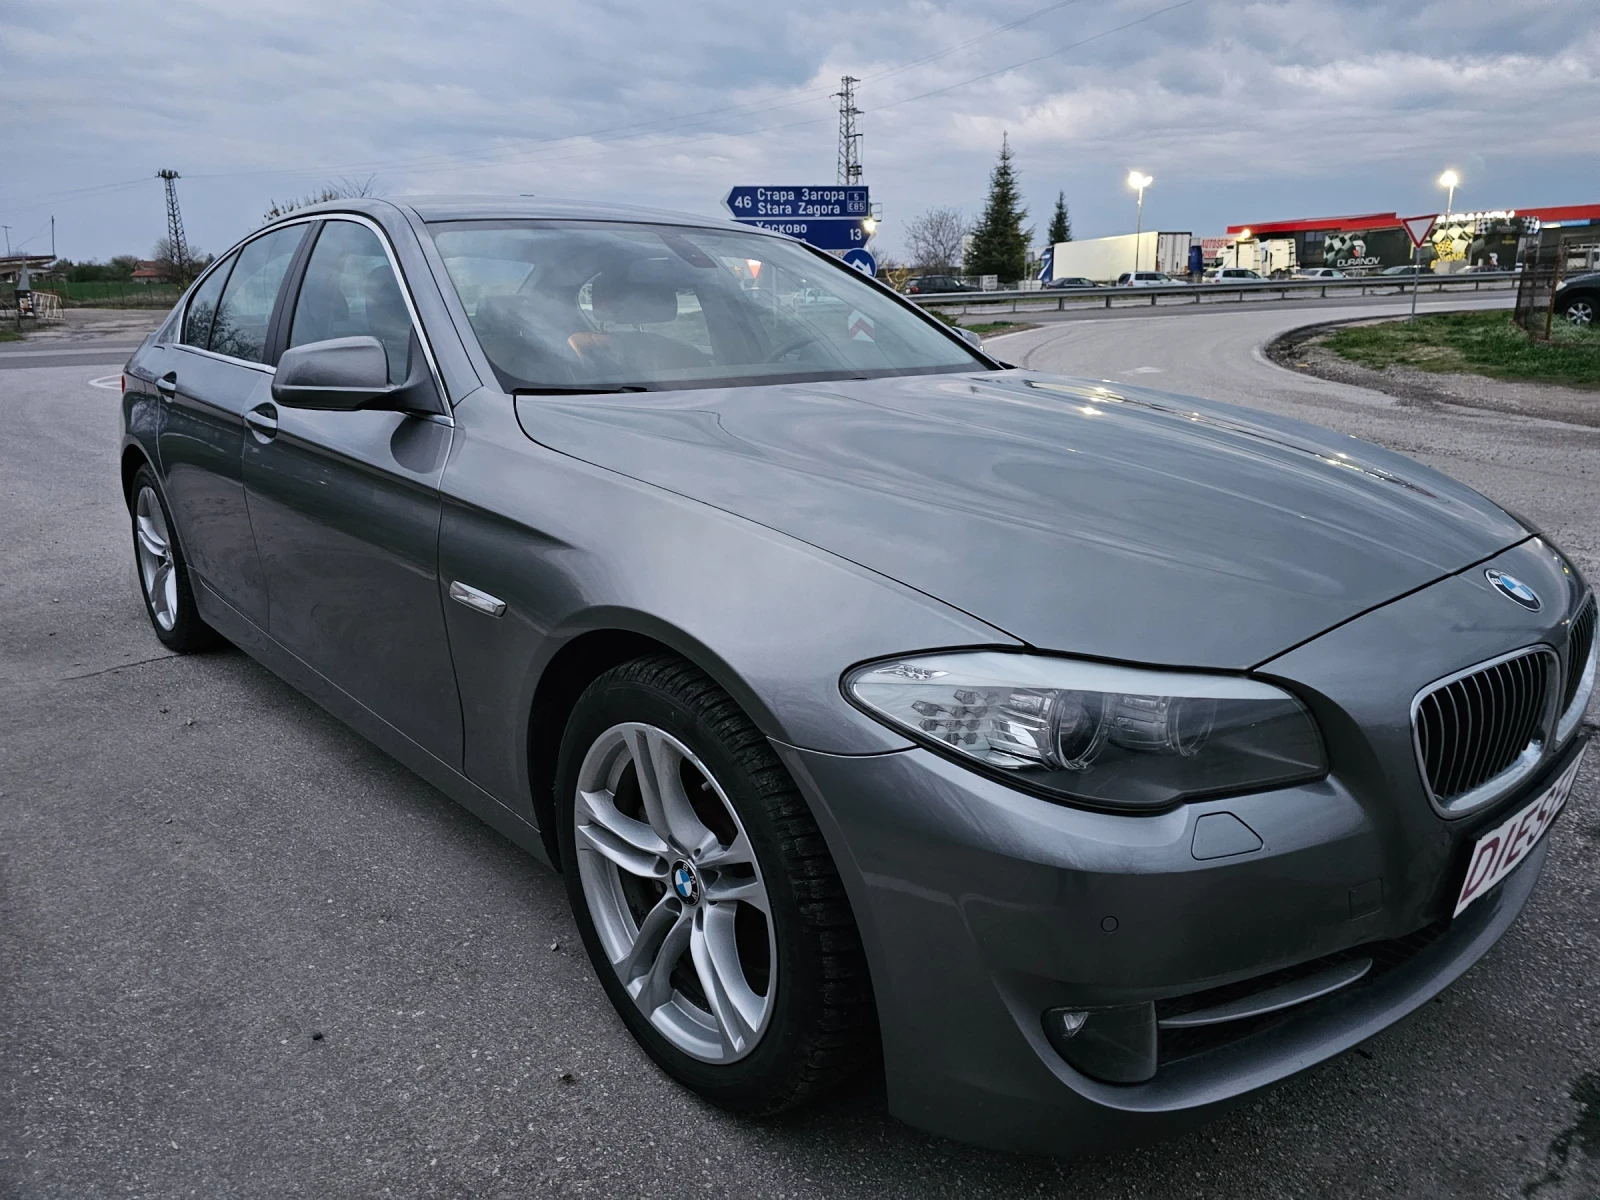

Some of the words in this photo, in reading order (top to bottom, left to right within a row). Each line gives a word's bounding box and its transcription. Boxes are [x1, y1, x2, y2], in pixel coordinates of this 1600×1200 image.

[734, 195, 752, 208] 46
[757, 188, 795, 203] Стара
[801, 188, 845, 203] Загора
[853, 193, 860, 201] 5
[757, 202, 792, 214] Stara
[798, 202, 840, 217] Zagora
[849, 202, 865, 211] E85
[850, 228, 862, 240] 13
